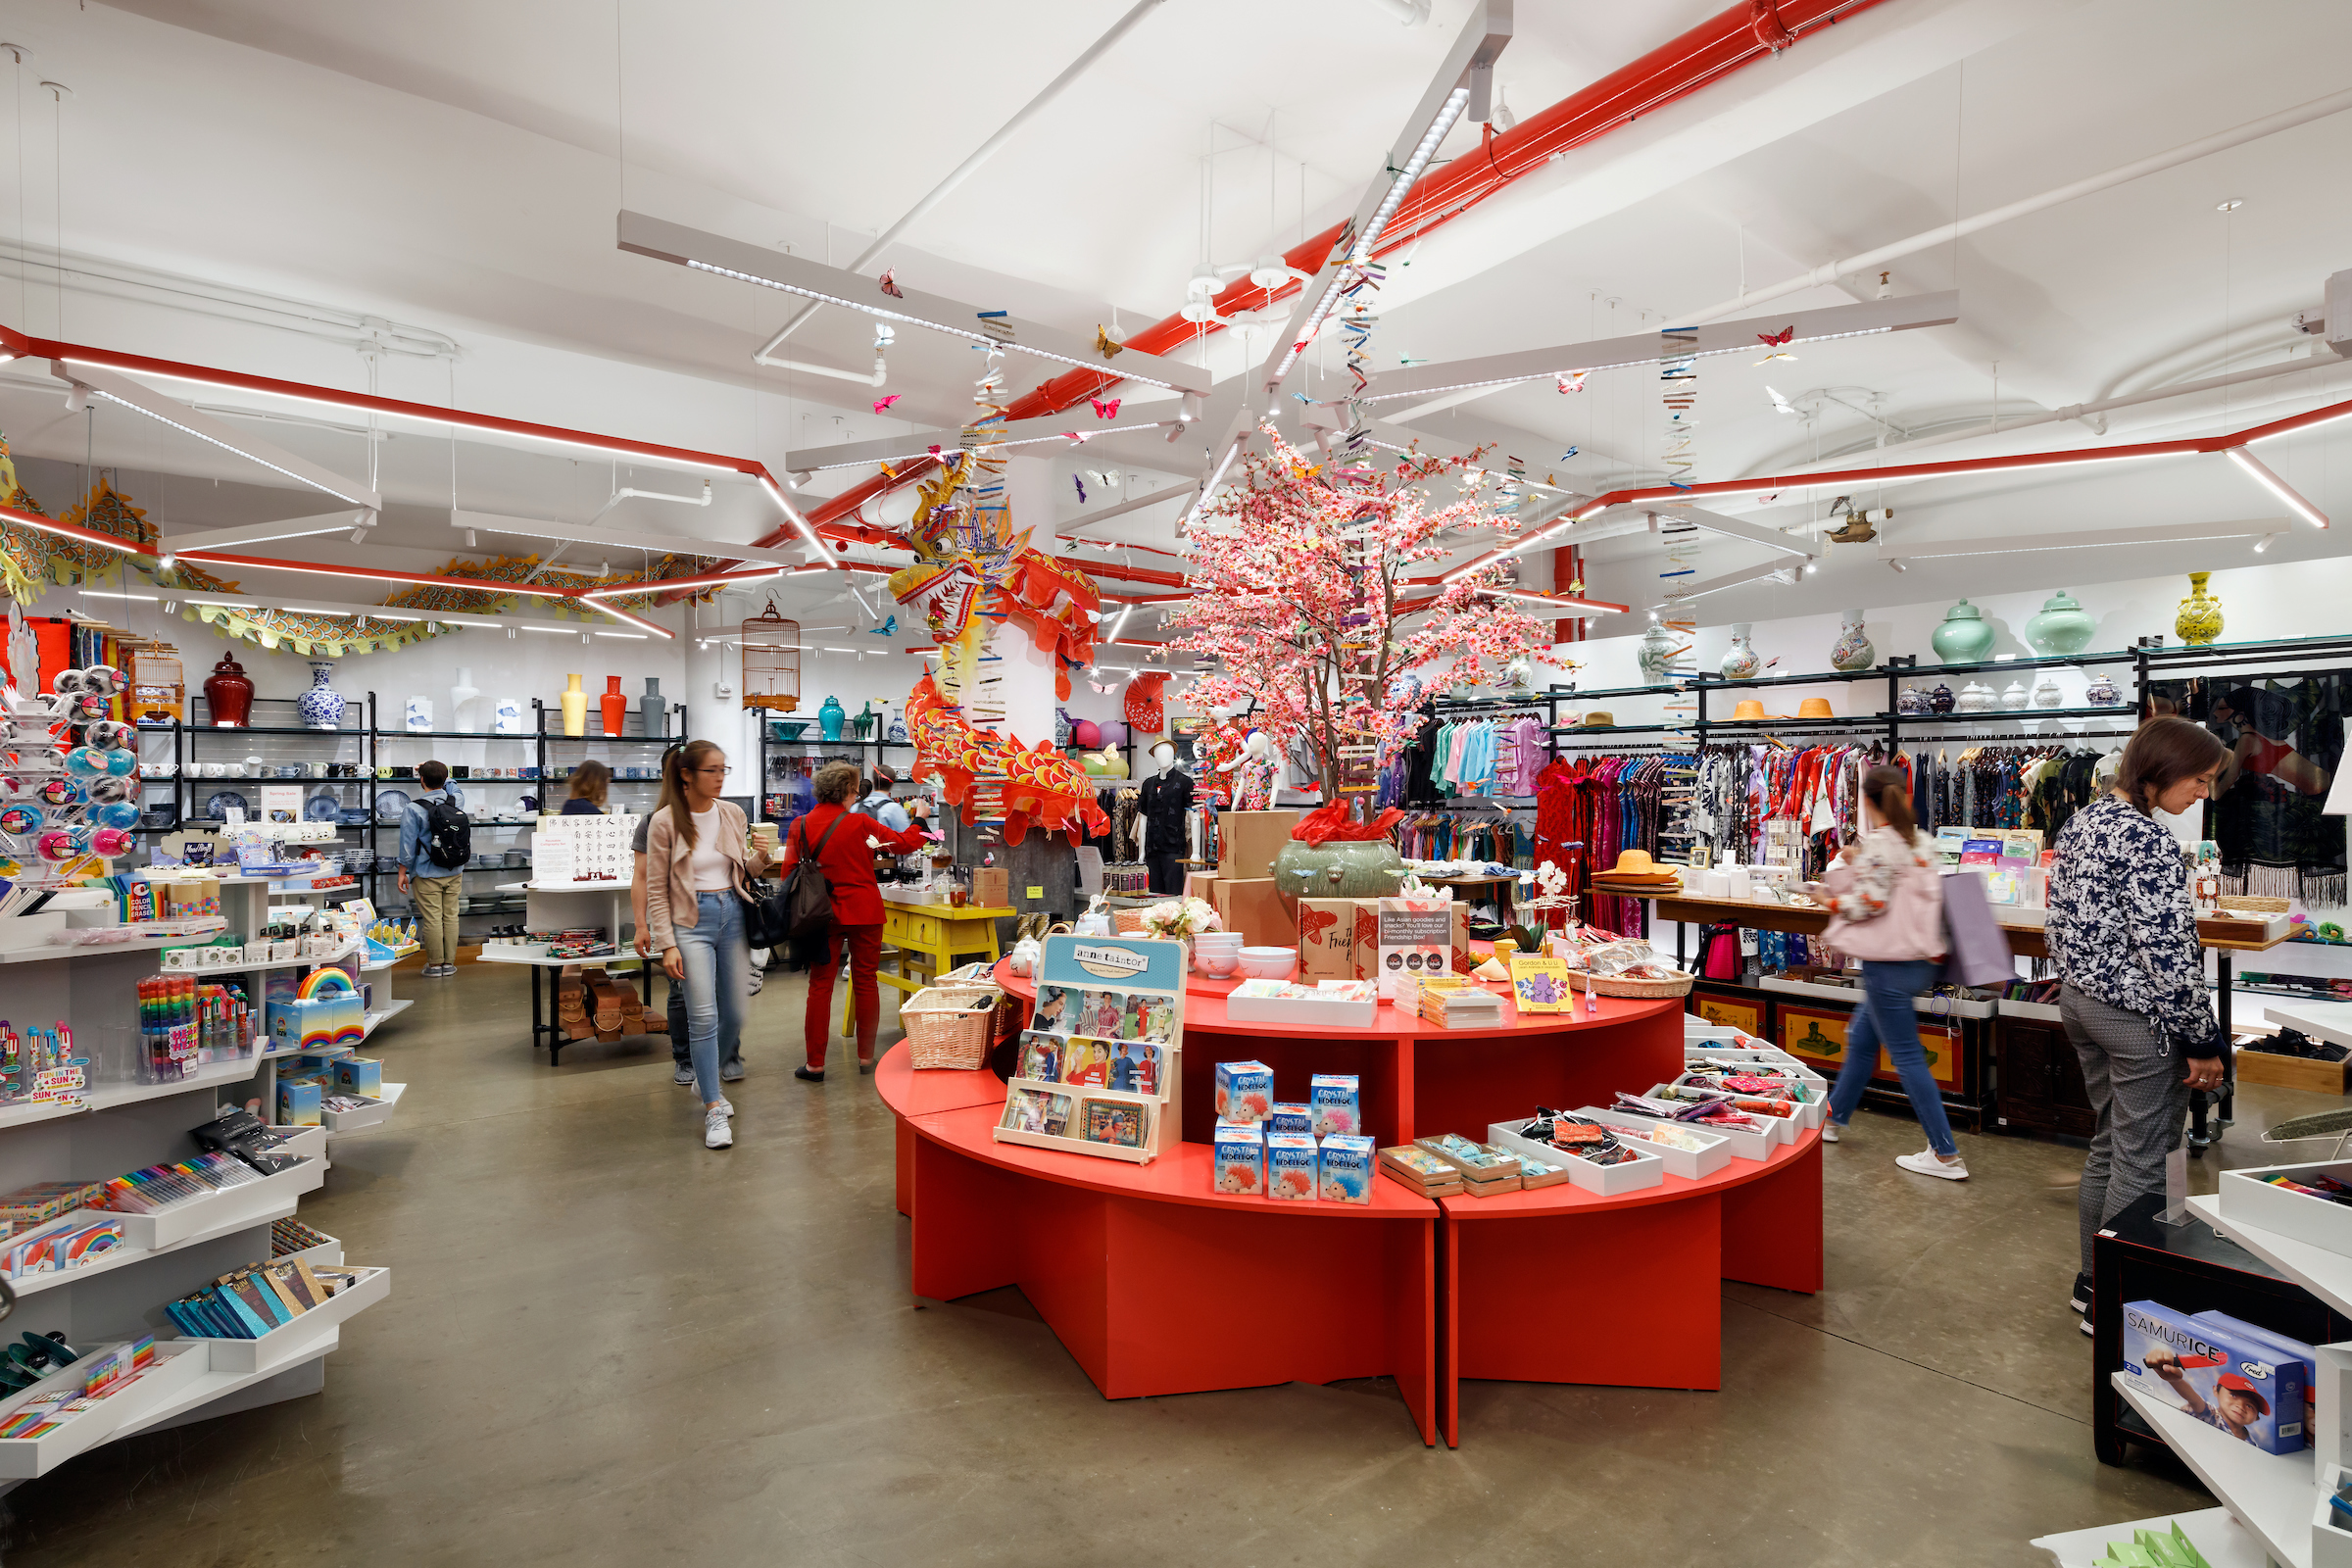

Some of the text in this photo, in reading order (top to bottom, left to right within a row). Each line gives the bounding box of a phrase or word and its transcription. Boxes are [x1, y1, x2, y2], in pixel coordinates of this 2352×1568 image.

[1077, 949, 1102, 960] anne
[51, 1076, 69, 1085] SUN
[1238, 1076, 1266, 1085] CRYSTAL
[33, 1091, 51, 1099] SUN
[1318, 1090, 1351, 1099] CRYSTAL
[1276, 1117, 1307, 1126] CRYSTAL
[1221, 1145, 1254, 1154] CRYSTA
[1276, 1151, 1309, 1160] CRYSTAL
[1327, 1152, 1360, 1162] CRYSTAL
[1327, 1159, 1361, 1169] HEDGEHOG
[2128, 1312, 2220, 1363] SAMURICE
[2244, 1364, 2262, 1376] Fred
